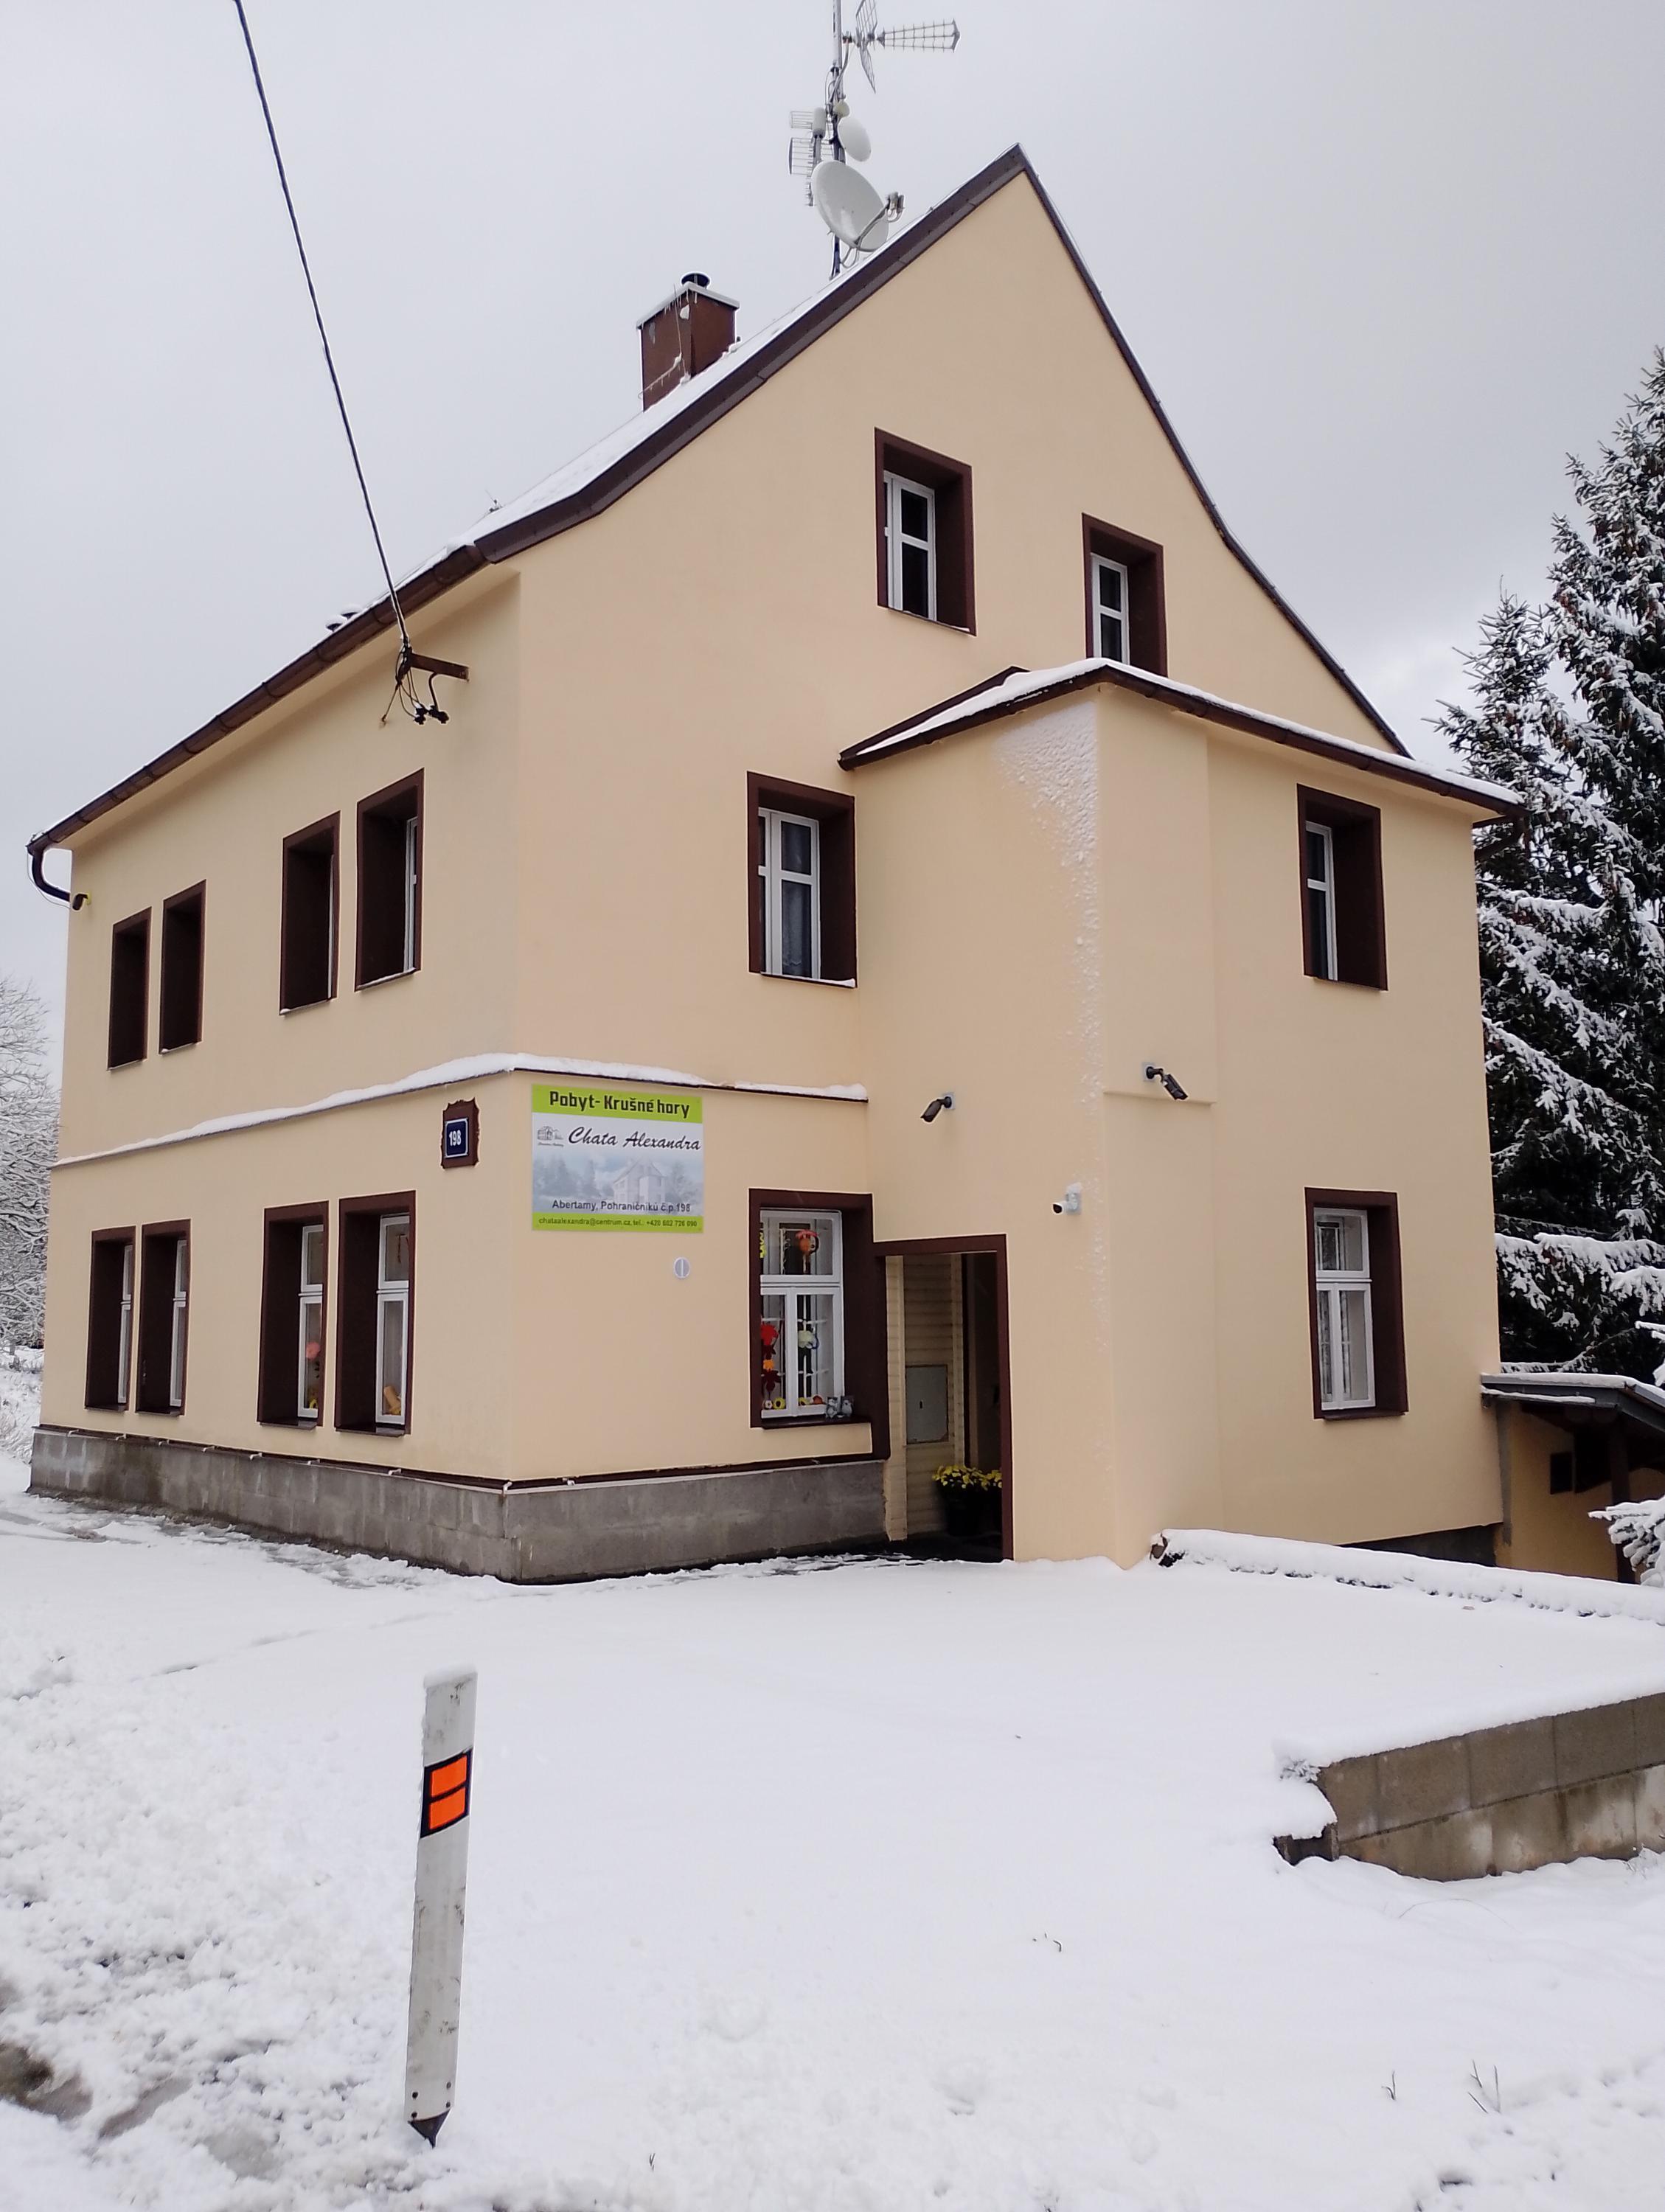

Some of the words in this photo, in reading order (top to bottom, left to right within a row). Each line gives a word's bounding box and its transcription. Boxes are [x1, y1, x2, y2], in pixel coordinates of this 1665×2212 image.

[549, 1091, 601, 1112] Pobyt-
[604, 1095, 654, 1113] Krušné
[657, 1099, 690, 1119] hory
[448, 1130, 462, 1147] 198
[568, 1127, 618, 1146] Chata
[623, 1130, 701, 1150] Alexandra
[552, 1200, 598, 1211] Abertamy,
